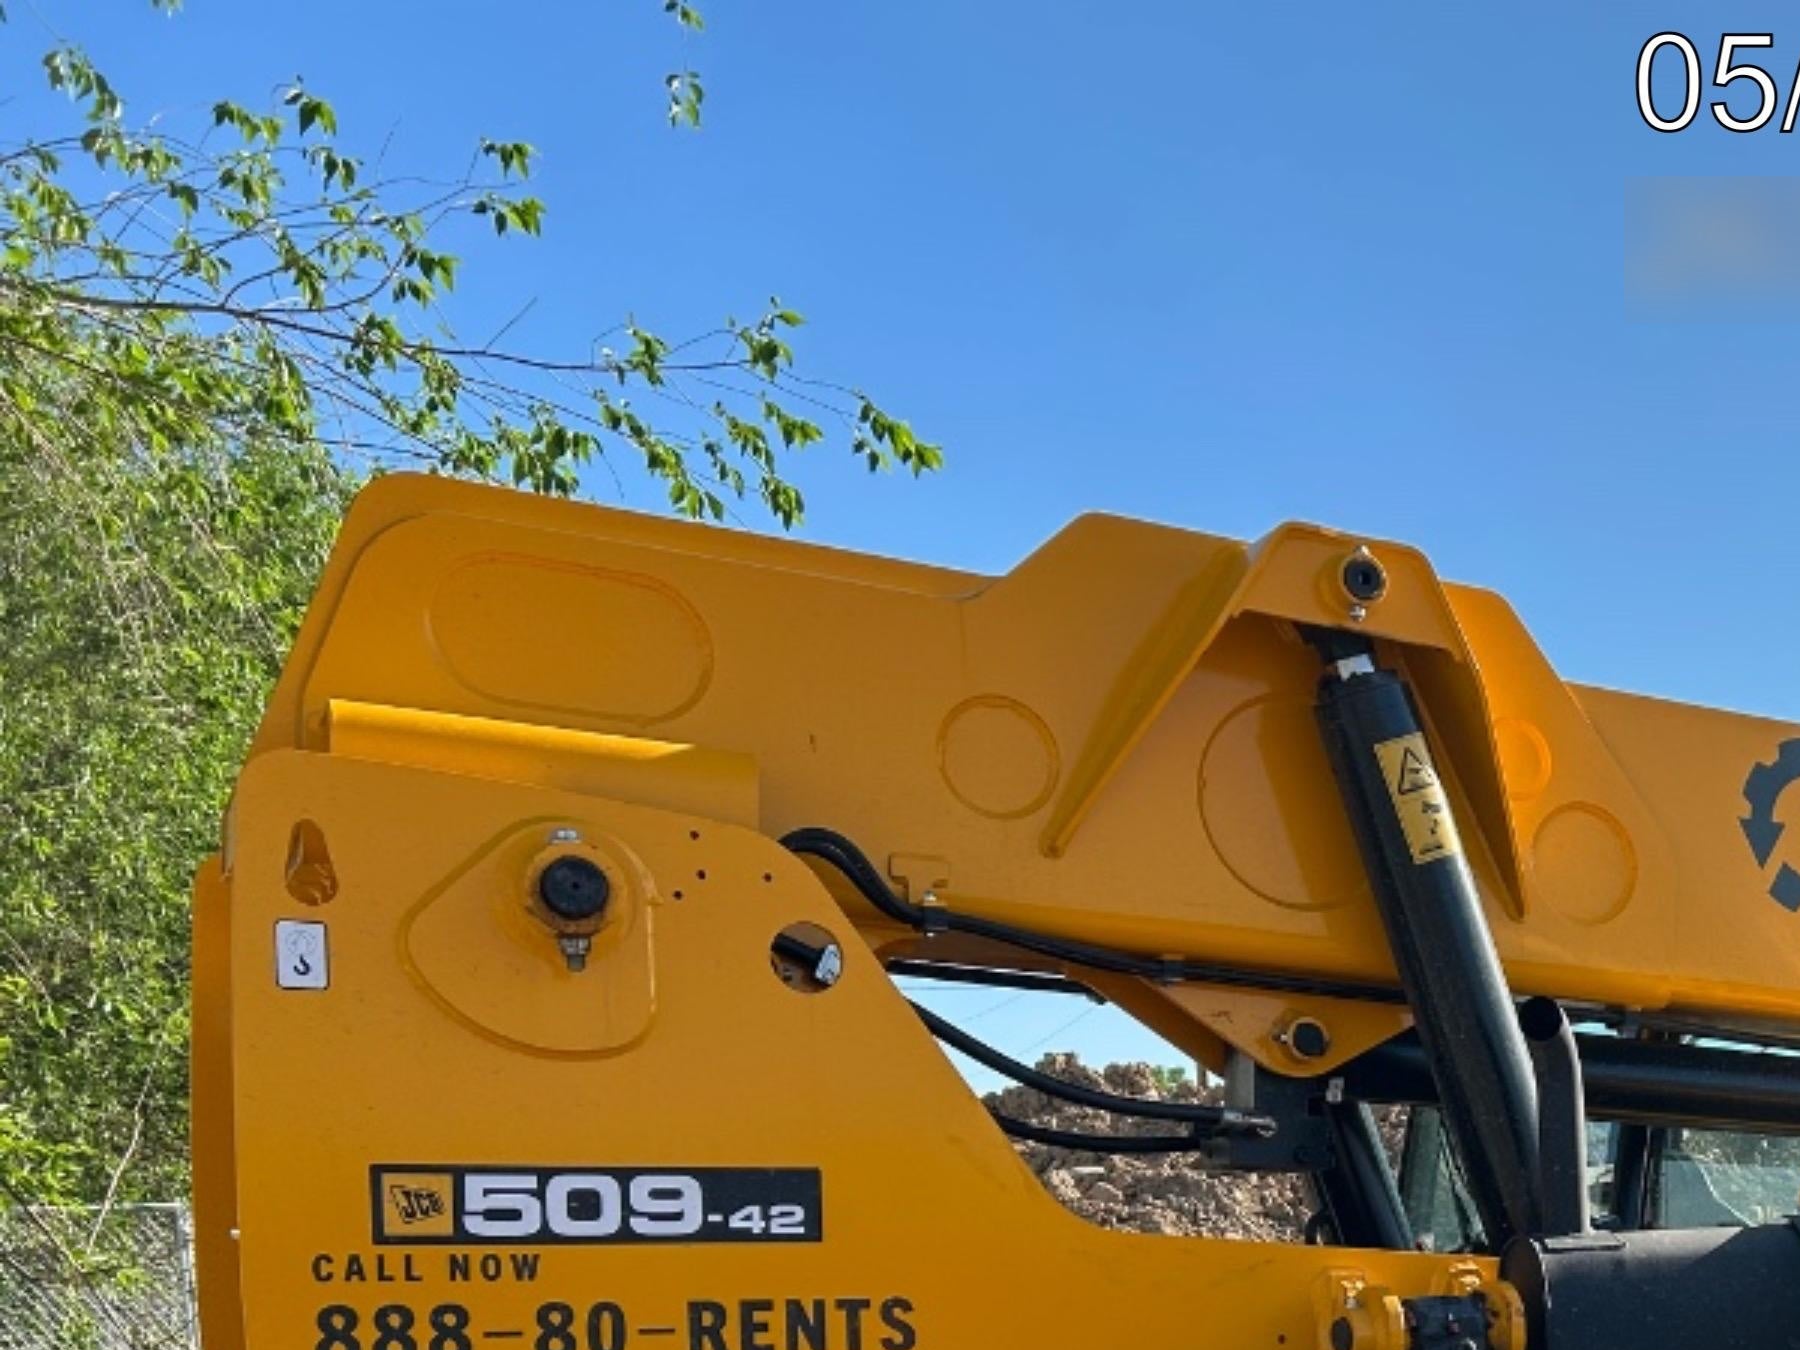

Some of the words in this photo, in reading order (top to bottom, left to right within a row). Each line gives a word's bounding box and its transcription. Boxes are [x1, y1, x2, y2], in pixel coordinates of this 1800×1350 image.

[462, 1174, 806, 1238] 509-42
[310, 1252, 424, 1284] CALL
[448, 1252, 542, 1283] NOW
